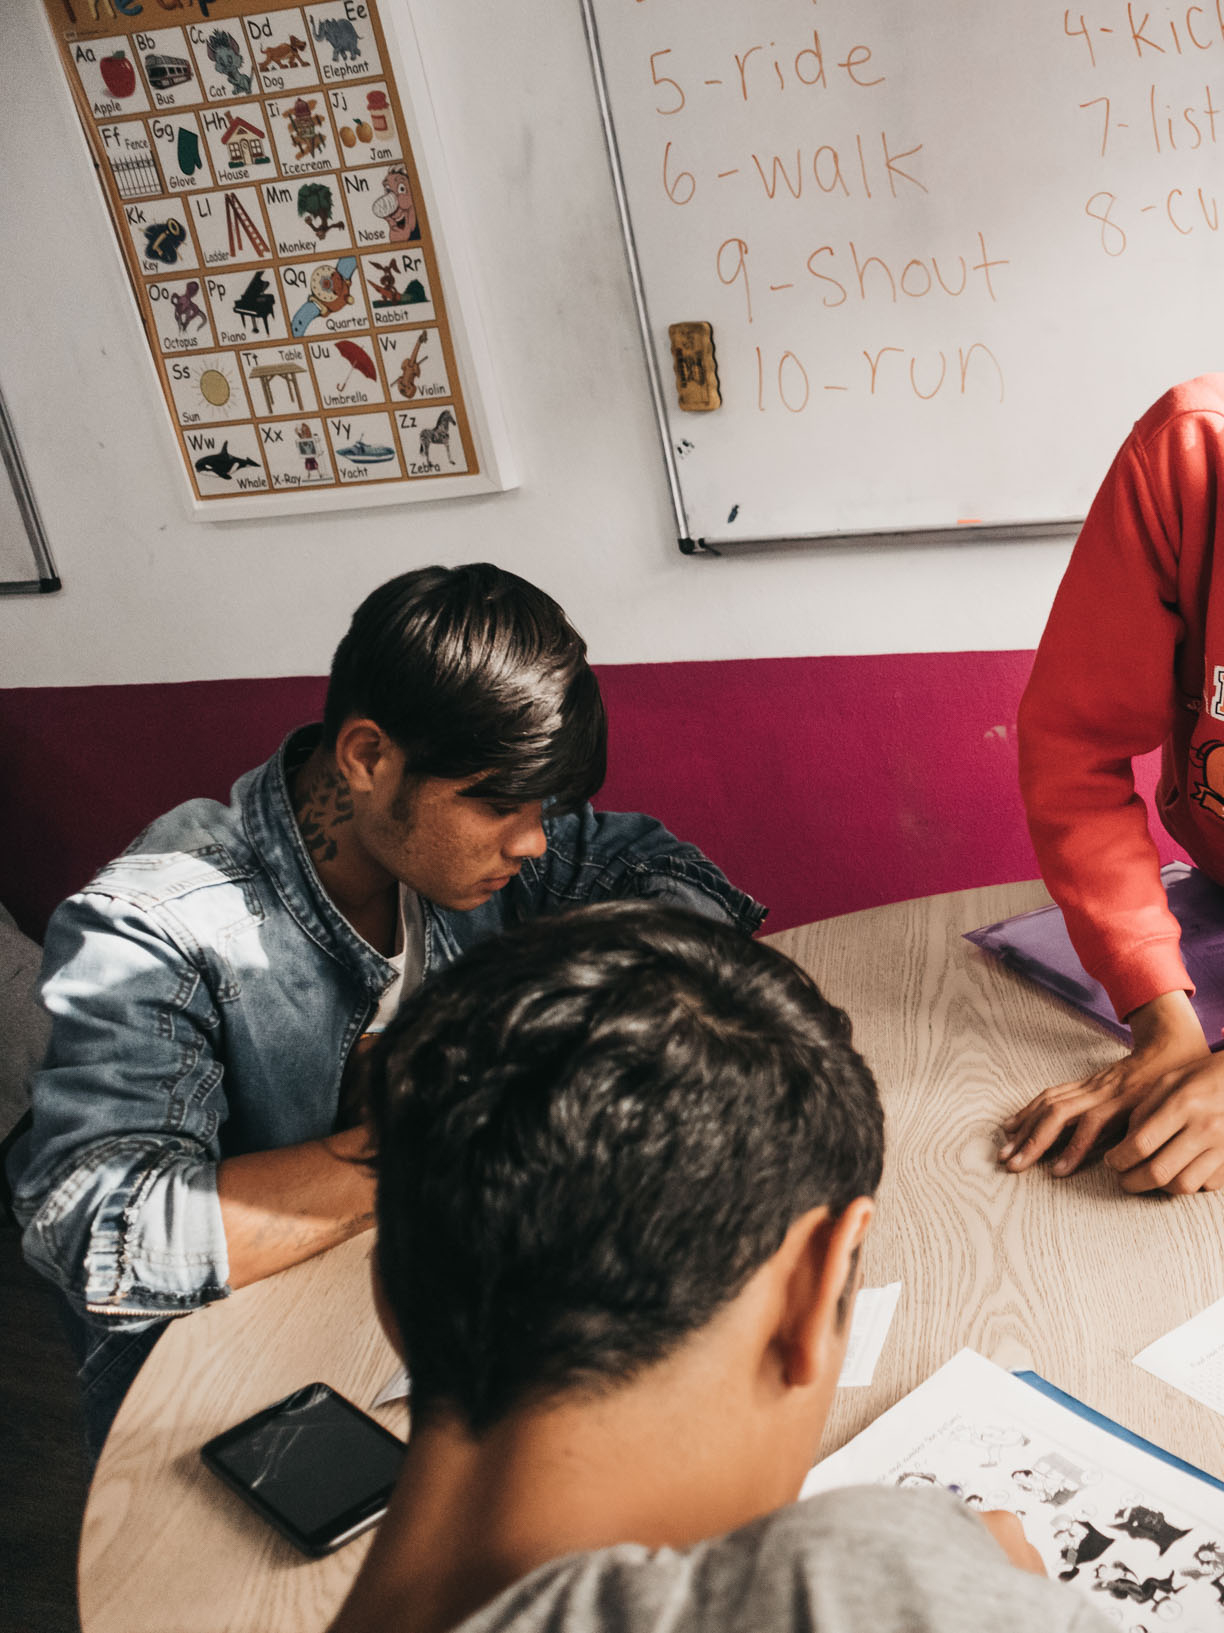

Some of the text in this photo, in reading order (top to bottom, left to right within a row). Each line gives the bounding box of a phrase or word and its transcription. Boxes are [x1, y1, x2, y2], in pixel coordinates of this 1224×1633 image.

[343, 0, 367, 21] Ee
[189, 26, 206, 44] Cc
[248, 17, 273, 40] Dd
[136, 35, 156, 51] Bb
[75, 45, 96, 63] Aa
[323, 61, 370, 80] Elephant
[649, 30, 886, 115] 5-ride
[263, 75, 285, 89] Dog
[156, 93, 175, 105] Bus
[209, 86, 227, 98] Cat
[94, 100, 122, 117] Apple
[331, 92, 348, 111] Jj
[267, 102, 280, 118] Ii
[203, 111, 227, 131] Hh
[101, 126, 120, 147] Ff
[152, 120, 174, 142] Gg
[124, 138, 149, 150] Fence
[369, 147, 393, 161] Jam
[282, 159, 332, 175] Icecream
[663, 131, 928, 205] 6-walk
[169, 176, 197, 188] Glove
[218, 169, 249, 182] House
[344, 175, 369, 194] Nn
[266, 186, 292, 205] Mm
[126, 205, 147, 225] Kk
[196, 197, 212, 218] Ll
[358, 229, 386, 242] Nose
[278, 241, 317, 254] Monkey
[142, 260, 159, 273] Key
[402, 255, 422, 272] Rr
[283, 267, 307, 288] Qq
[716, 232, 1011, 324] 9-shout
[149, 284, 169, 301] Oo
[207, 279, 226, 301] Pp
[325, 317, 368, 332] Quarter
[375, 310, 409, 324] Rabbit
[221, 331, 246, 343] Piano
[379, 336, 397, 351] Vv
[242, 352, 258, 366] Tt
[278, 349, 303, 361] Table
[311, 345, 330, 359] Uu
[172, 363, 191, 380] Ss
[754, 343, 1004, 413] 10-run
[418, 384, 446, 396] Violin
[323, 391, 368, 406] Umbrella
[182, 412, 201, 423] Sun
[399, 414, 418, 428] Zz
[261, 427, 284, 443] Xx
[331, 420, 351, 440] Yy
[187, 434, 215, 451] Ww
[340, 467, 368, 479] Yacht
[409, 463, 441, 474] Zebra
[237, 479, 267, 490] Whale
